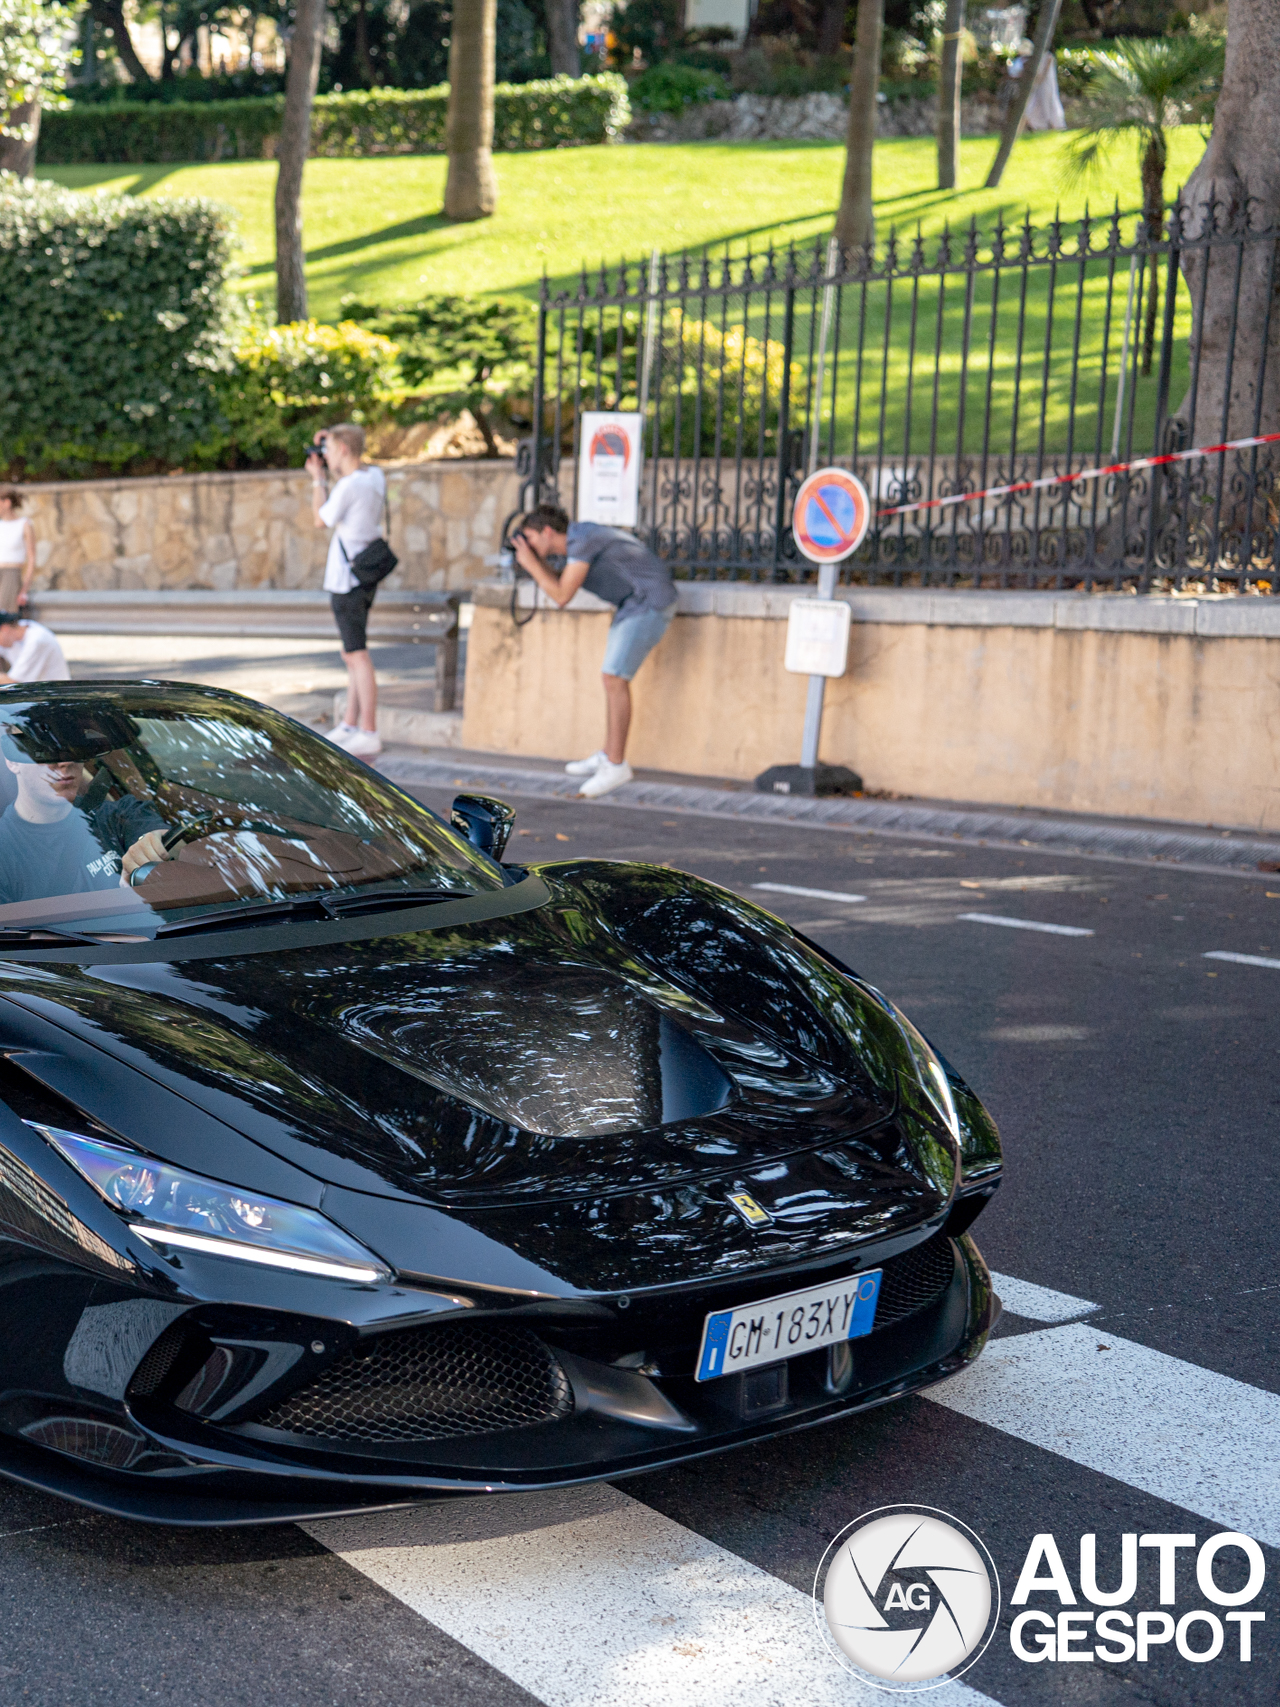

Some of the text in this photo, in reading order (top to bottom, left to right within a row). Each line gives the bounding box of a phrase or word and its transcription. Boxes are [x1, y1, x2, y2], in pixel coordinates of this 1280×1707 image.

[86, 859, 104, 878] PALM
[103, 860, 118, 877] CITY
[729, 1291, 858, 1360] GM 183XY
